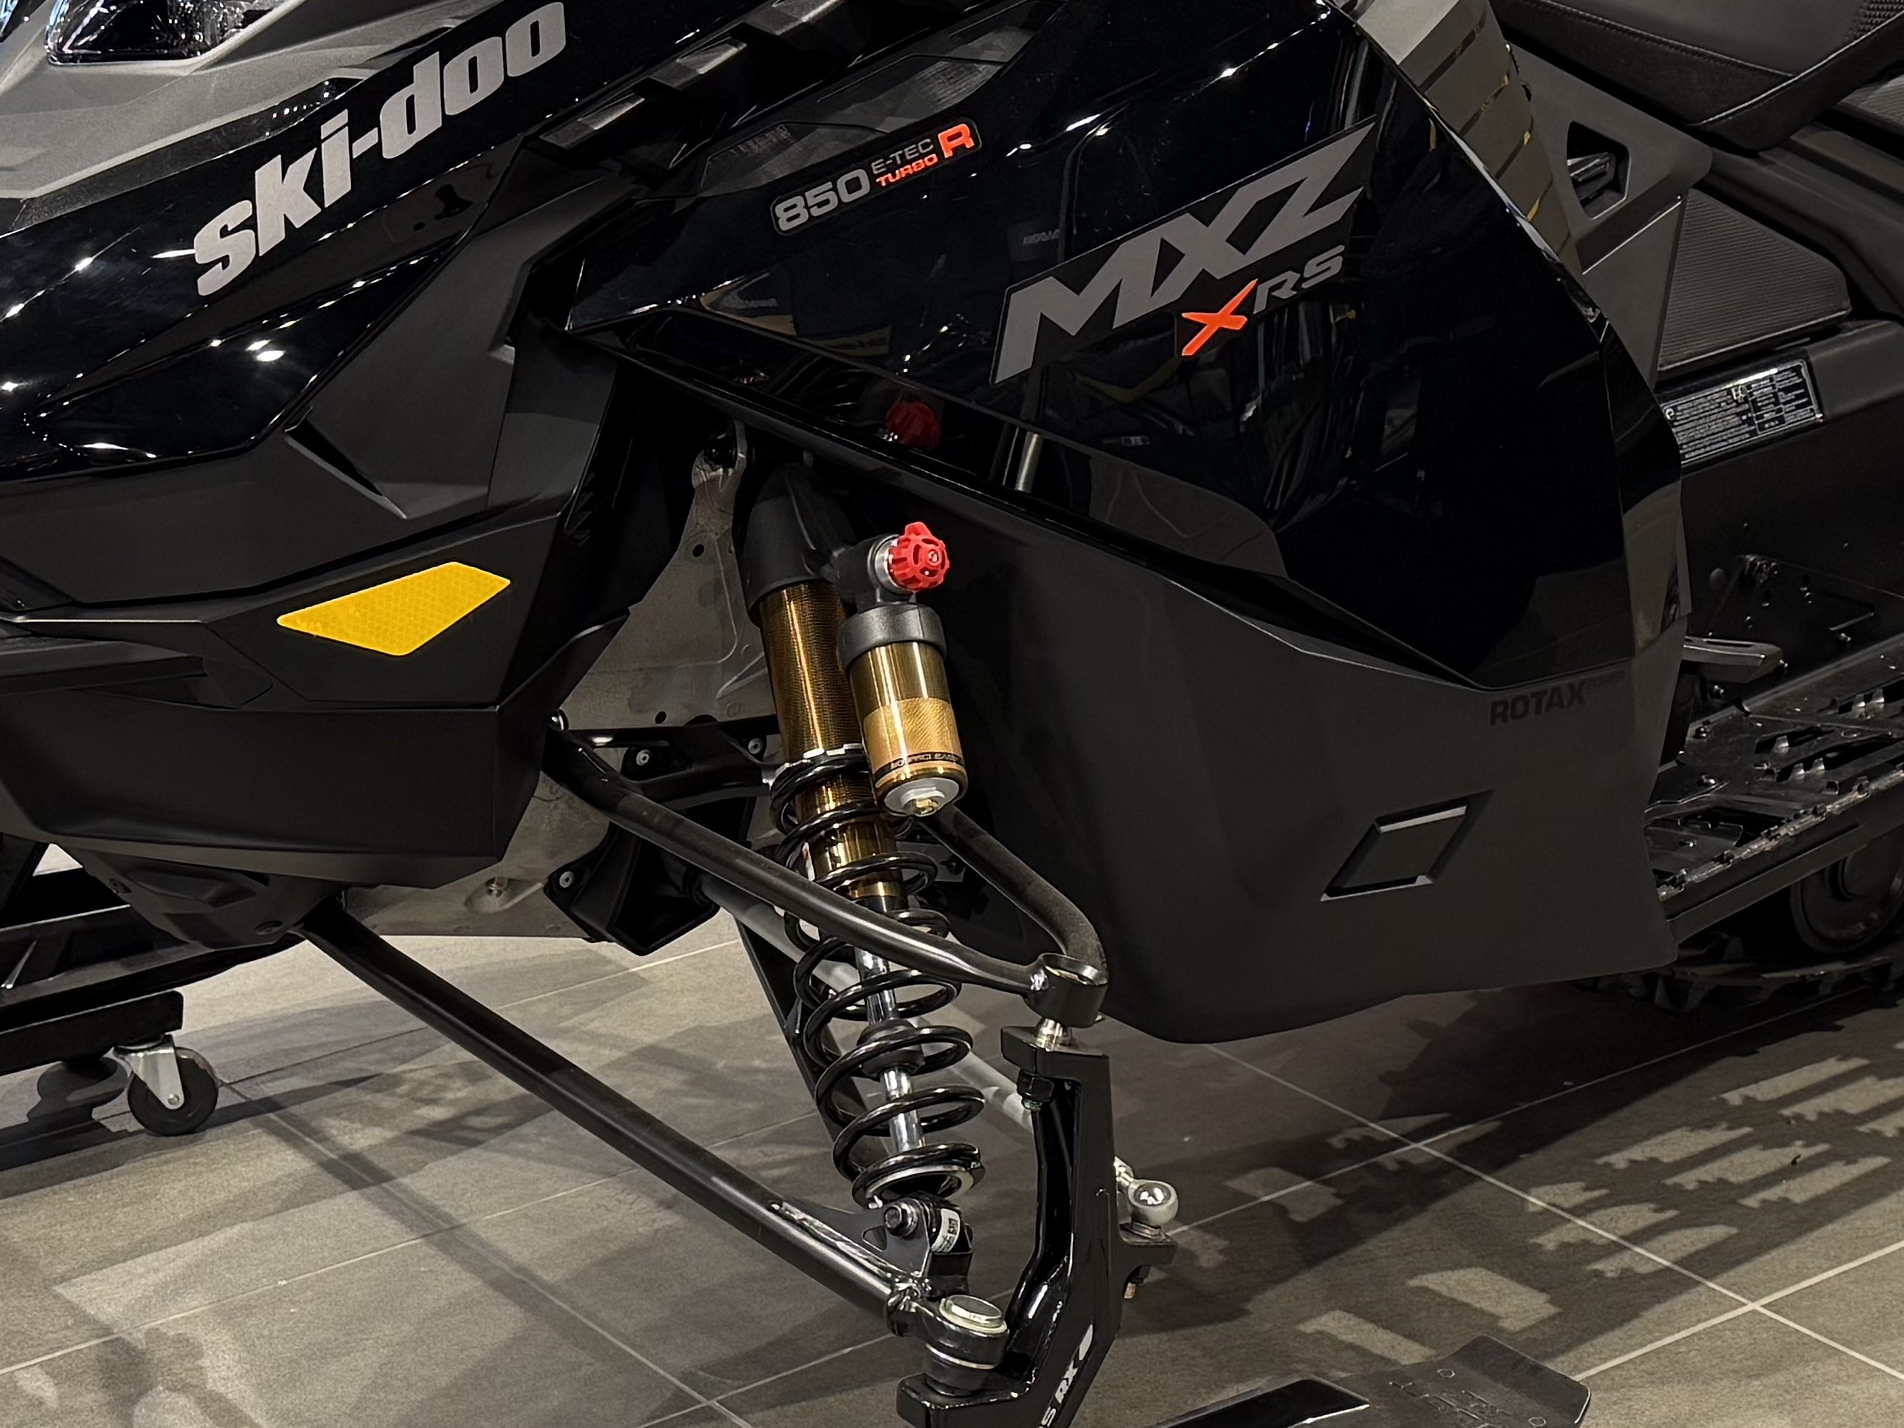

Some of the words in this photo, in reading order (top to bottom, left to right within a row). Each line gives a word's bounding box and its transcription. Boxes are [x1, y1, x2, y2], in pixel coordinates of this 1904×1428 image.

[193, 1, 567, 297] ski-doo
[774, 168, 871, 232] 850
[870, 137, 935, 175] E-TEC
[937, 122, 976, 160] R
[875, 153, 939, 187] TURBO
[995, 122, 1376, 385] MXZ
[1180, 277, 1259, 357] X
[1252, 243, 1347, 315] RS
[1489, 679, 1587, 727] ROTAX
